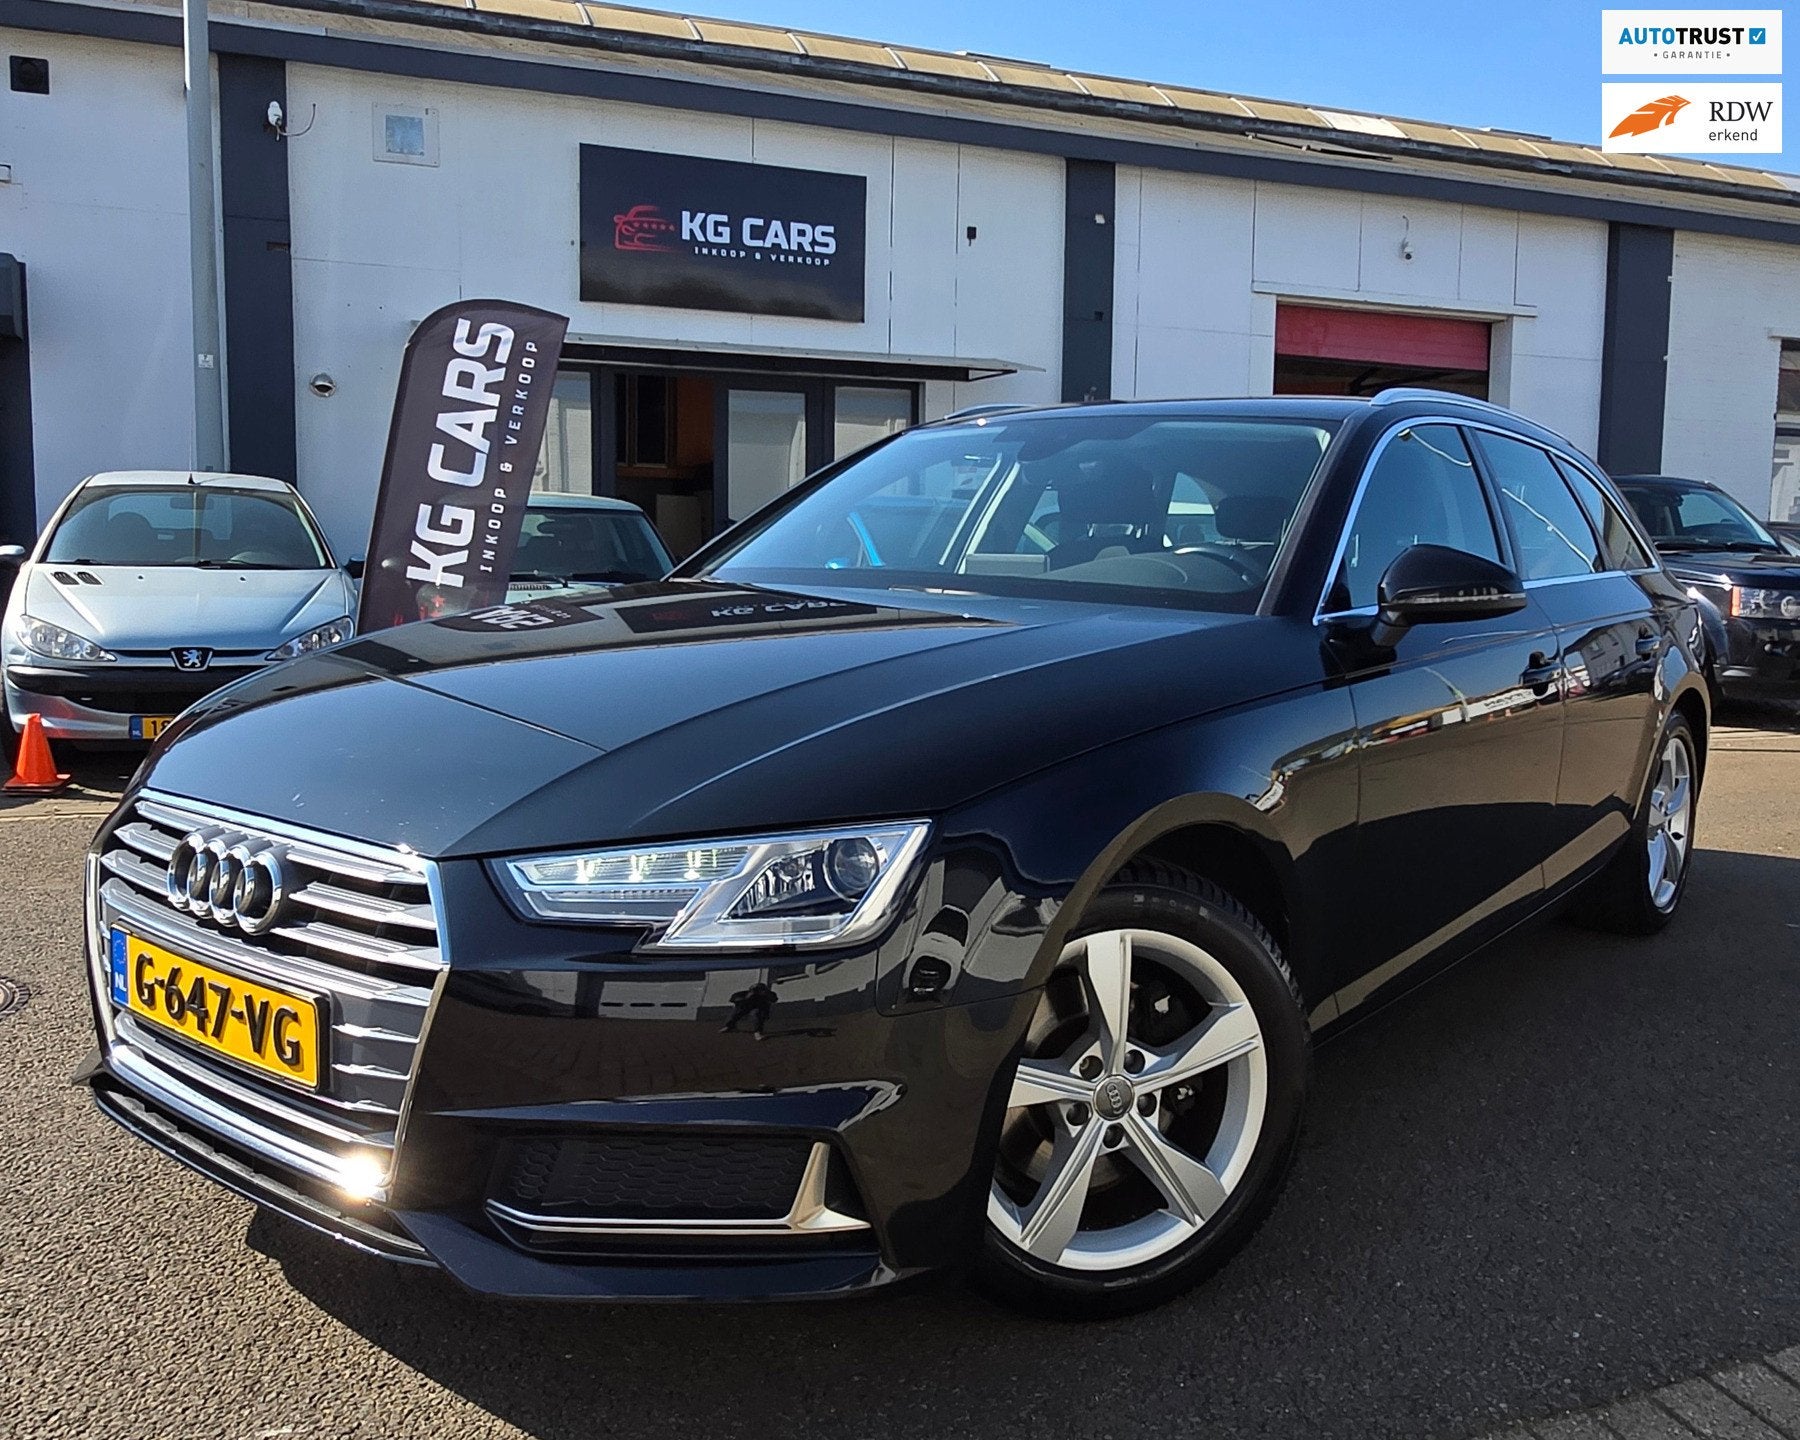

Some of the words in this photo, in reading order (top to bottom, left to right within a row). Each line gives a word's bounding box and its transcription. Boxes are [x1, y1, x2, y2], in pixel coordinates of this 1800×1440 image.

[681, 210, 731, 244] KG
[742, 217, 837, 255] CARS
[694, 246, 746, 258] INKOOP
[770, 253, 831, 266] VERKOOP
[427, 317, 515, 487] CARS
[480, 487, 507, 573] INKOOP
[505, 340, 538, 446] VERKOOP
[406, 503, 475, 588] KG
[114, 971, 127, 992] NL
[135, 952, 302, 1067] G-647-VG
